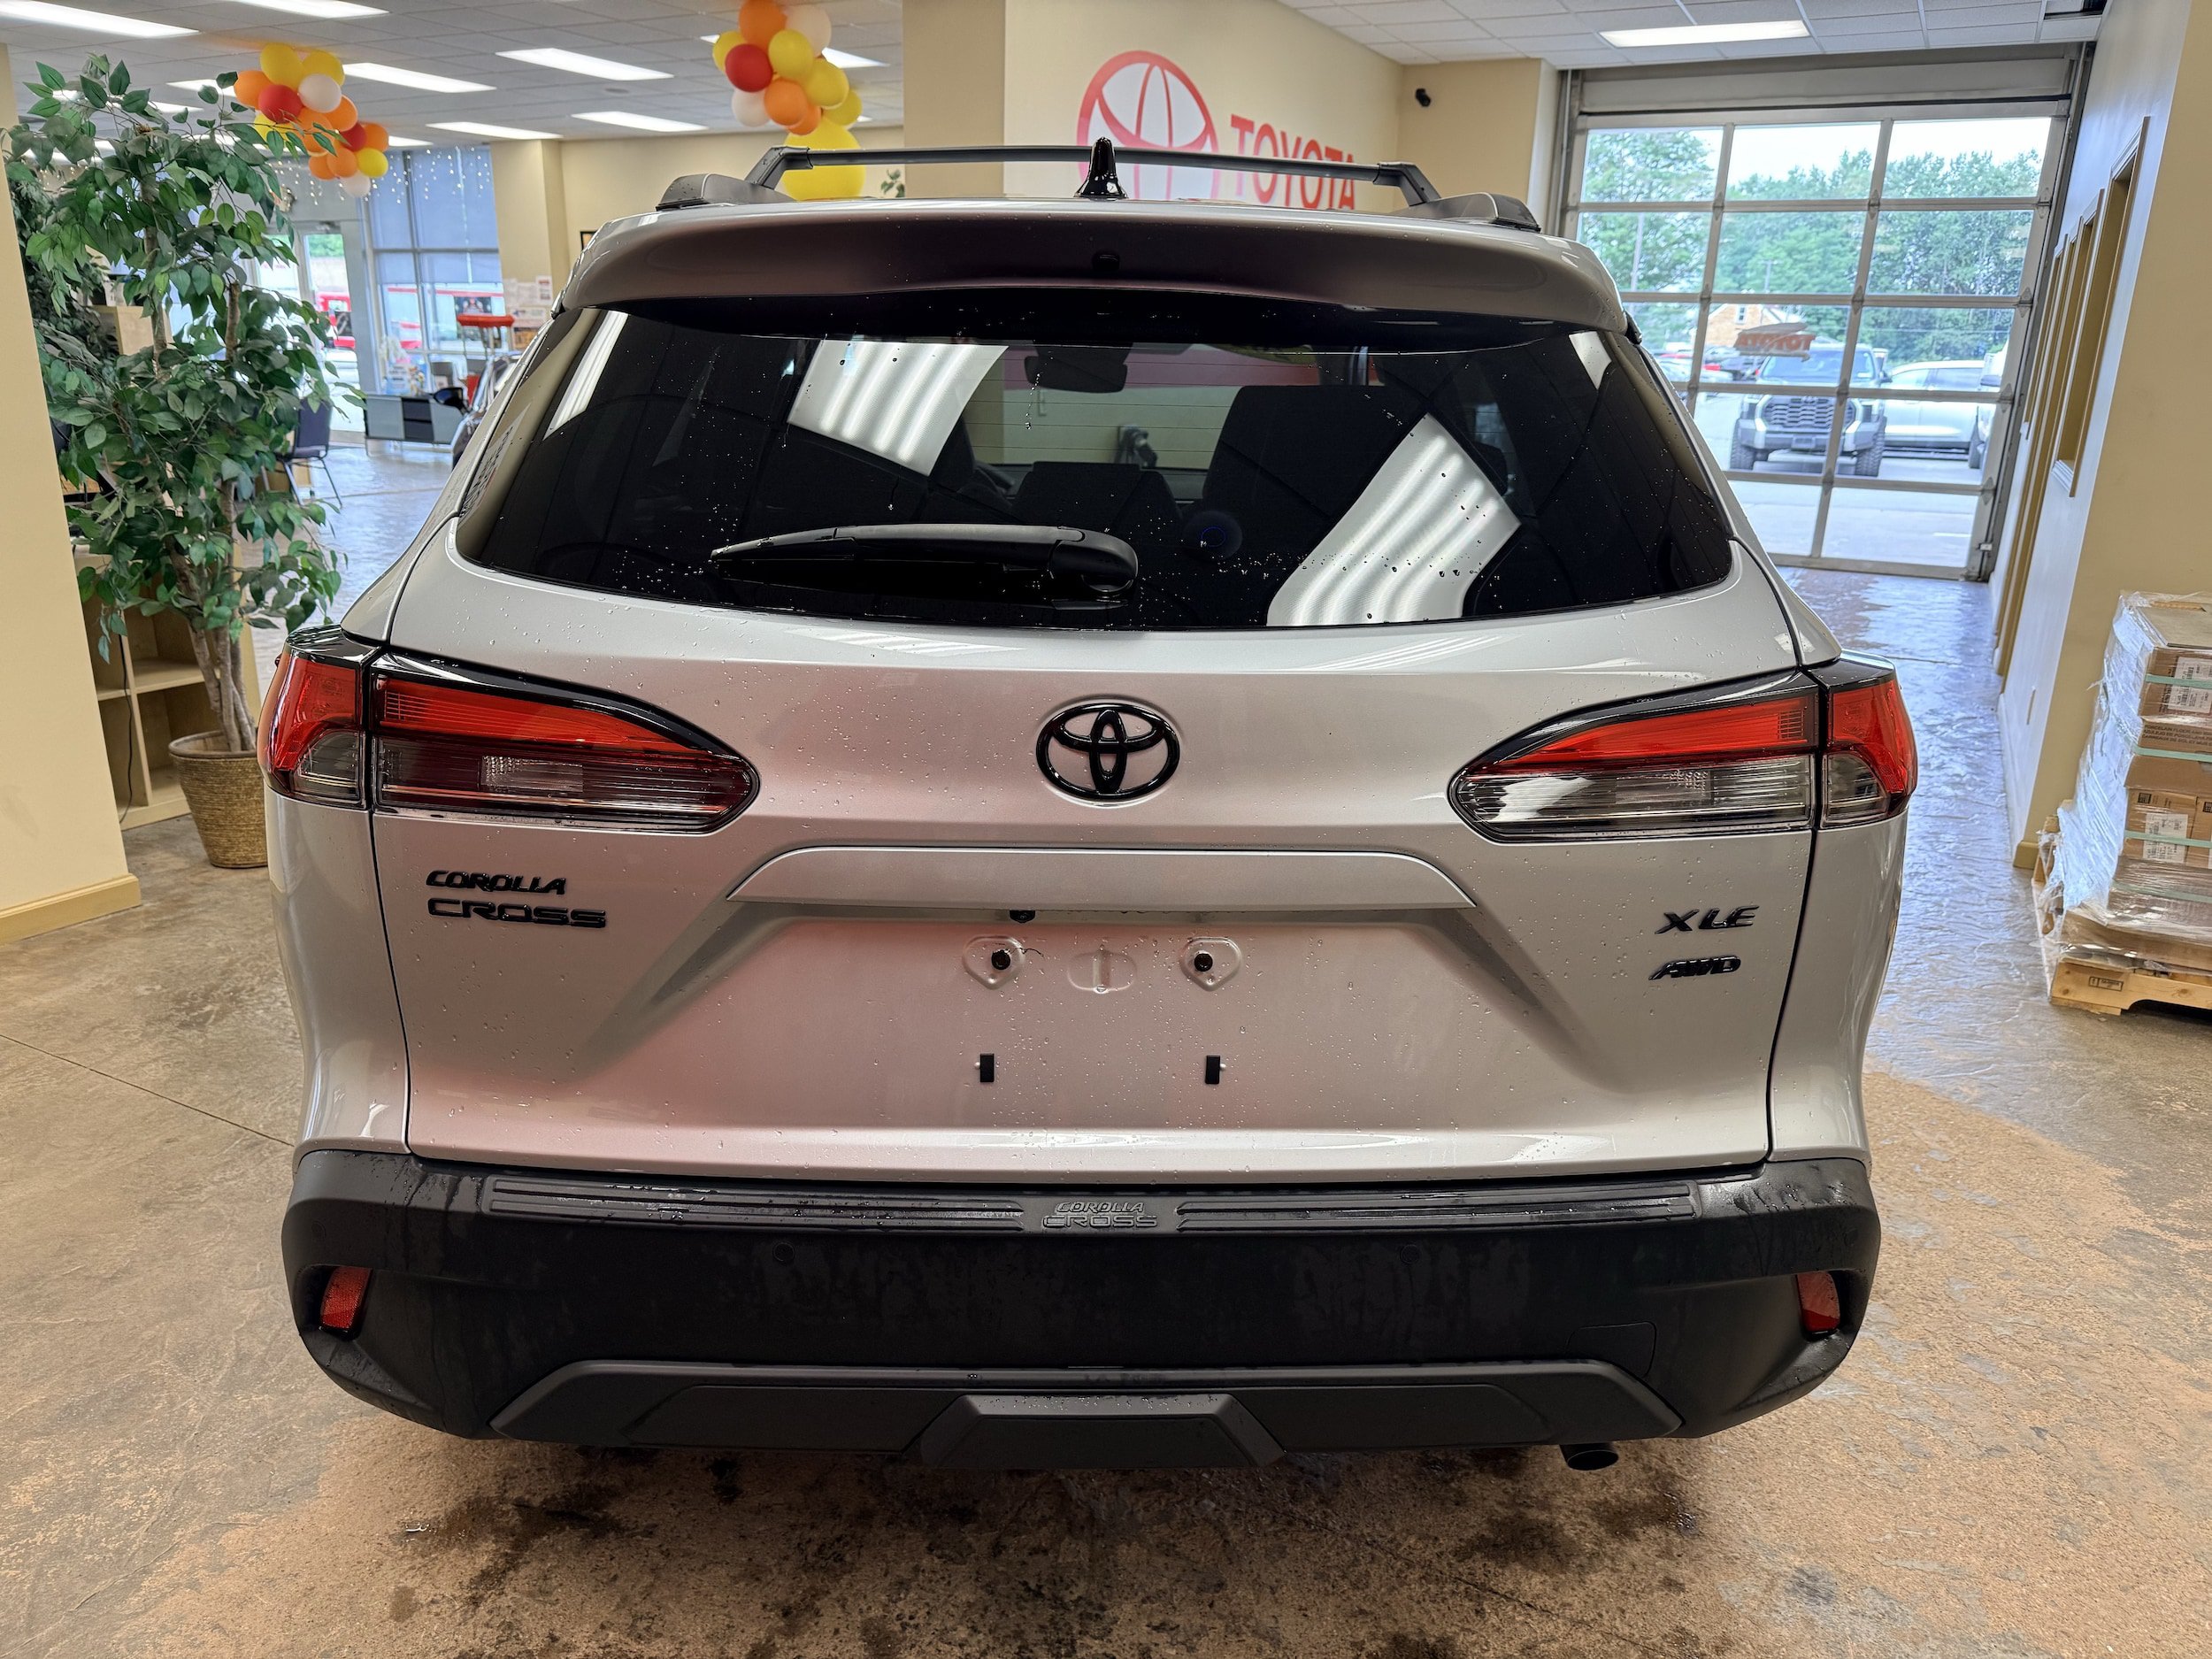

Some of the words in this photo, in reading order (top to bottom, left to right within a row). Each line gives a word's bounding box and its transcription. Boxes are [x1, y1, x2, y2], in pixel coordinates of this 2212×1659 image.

[1231, 113, 1355, 211] TOYOTA
[426, 870, 567, 895] COROLLA
[428, 898, 606, 928] CROSS
[1655, 905, 1760, 934] XLE
[1648, 955, 1741, 980] AWD
[1056, 1202, 1144, 1213] COROLLA
[1042, 1215, 1157, 1229] CROSS
